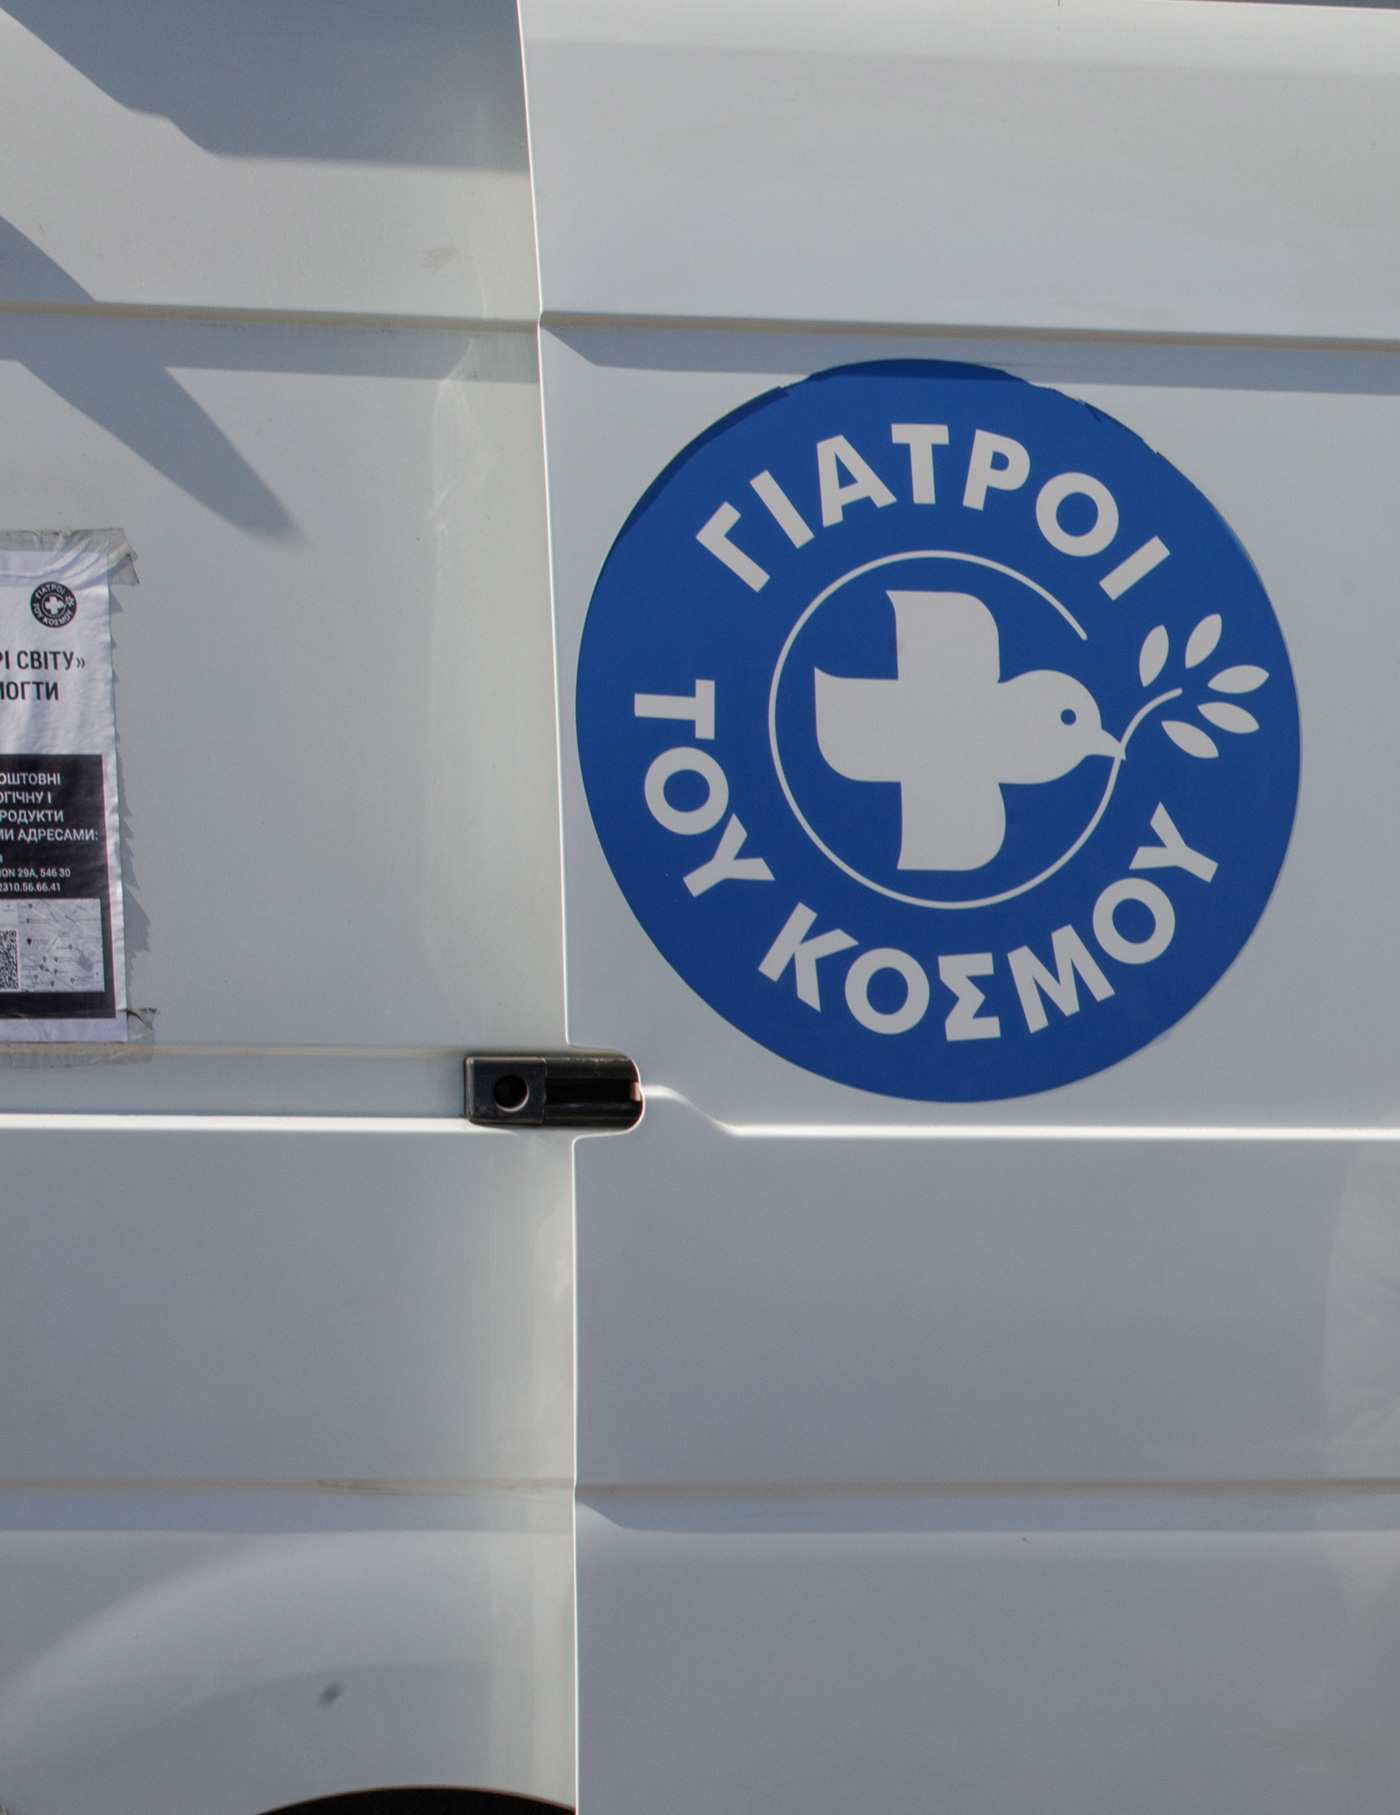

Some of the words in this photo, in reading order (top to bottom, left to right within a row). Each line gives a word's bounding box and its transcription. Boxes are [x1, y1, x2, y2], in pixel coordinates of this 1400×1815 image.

[695, 423, 1170, 601] ΓΙΑΤΡΟΙ
[17, 650, 86, 670] СВІТУ»
[17, 828, 99, 843] АДРЕСАМИ:
[633, 679, 776, 898] ΤΟΥ
[758, 802, 1218, 1042] ΚΟΣΜΟΥ
[40, 868, 57, 878] 546
[59, 868, 71, 878] 30
